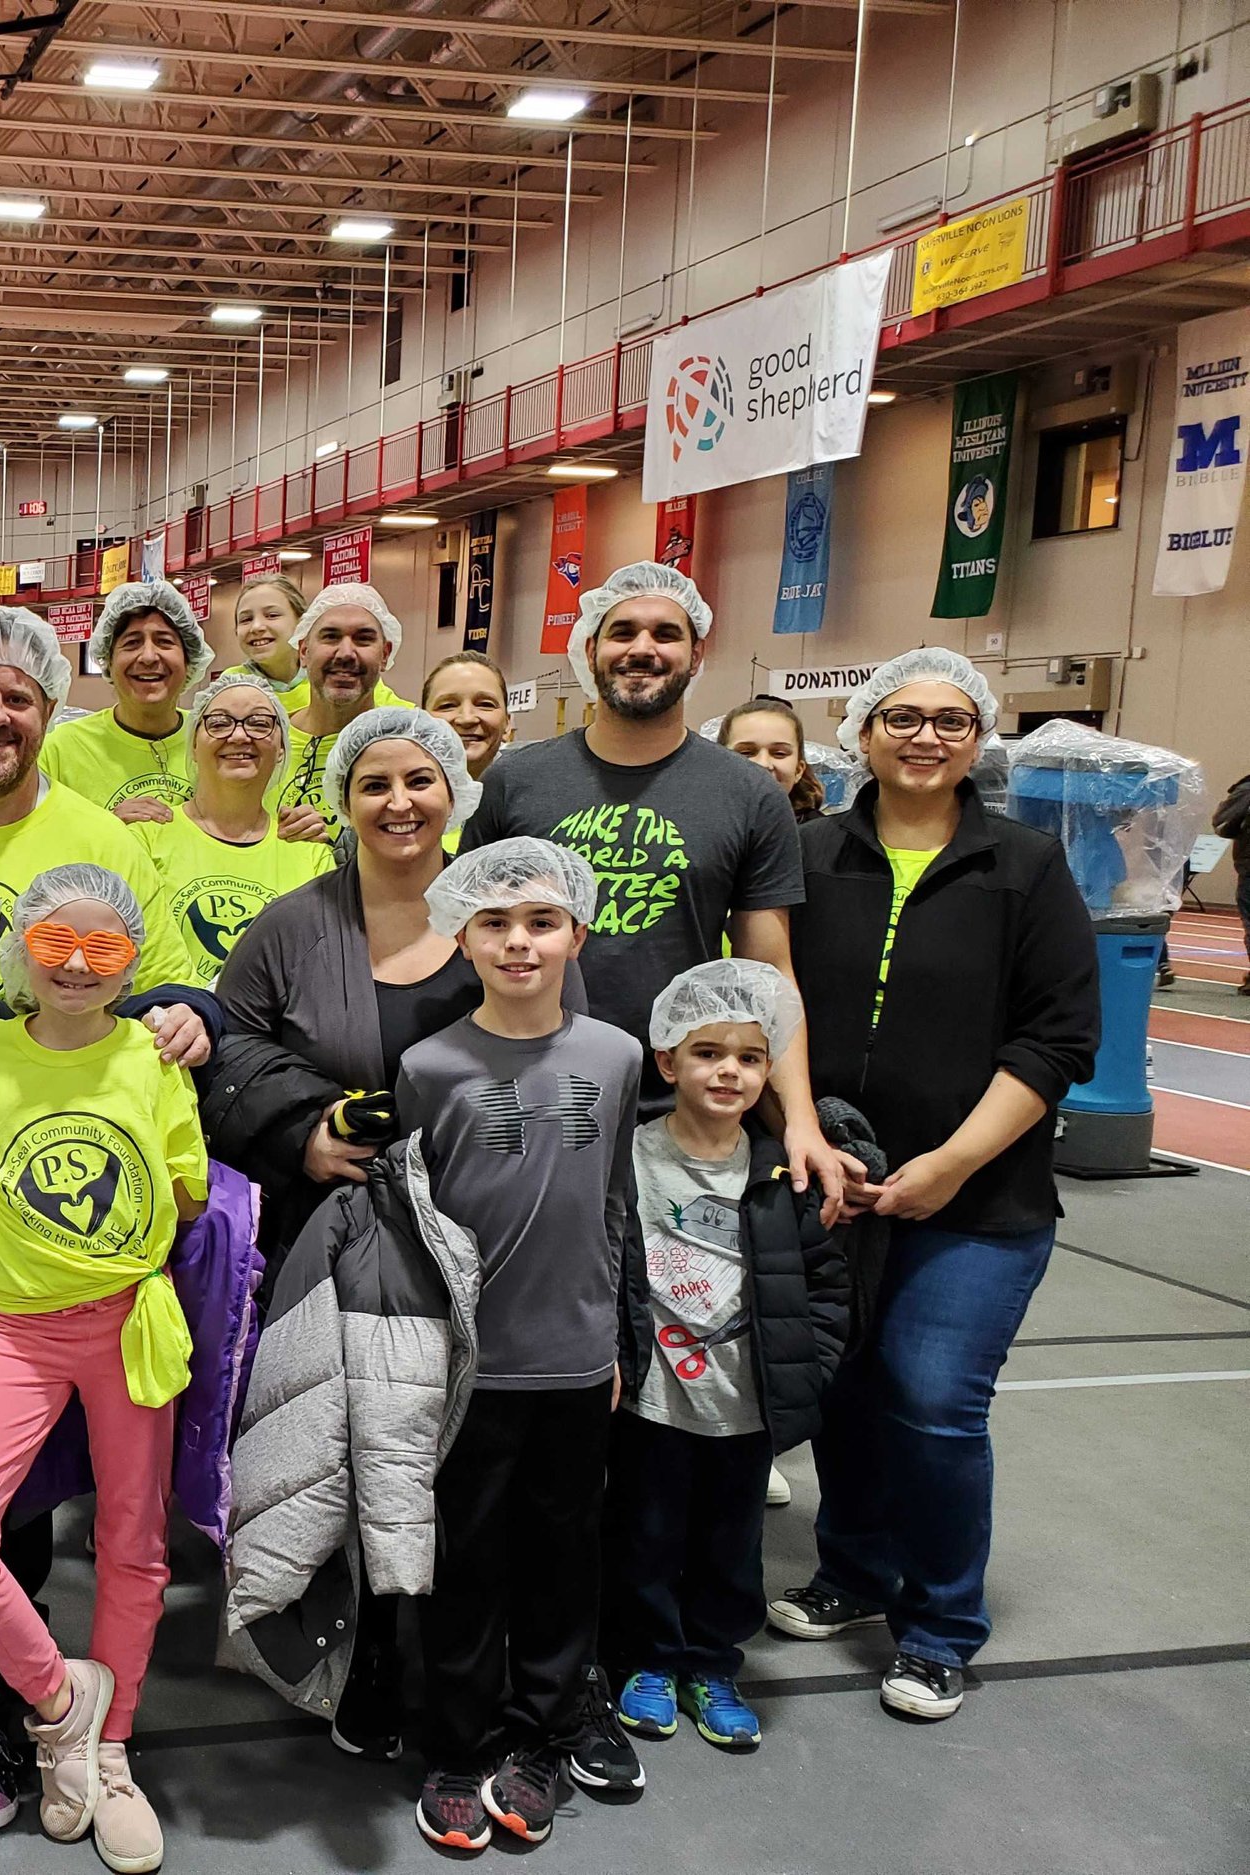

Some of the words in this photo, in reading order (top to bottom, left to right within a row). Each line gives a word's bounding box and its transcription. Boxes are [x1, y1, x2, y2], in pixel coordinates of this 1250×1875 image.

[966, 217, 996, 234] NOON
[998, 205, 1023, 223] LIONS
[940, 255, 956, 266] WE
[749, 333, 812, 390] good
[747, 359, 863, 422] shepherd
[1176, 415, 1242, 472] M
[952, 558, 996, 579] TITANS
[510, 689, 531, 706] FFLE
[550, 803, 630, 844] MAKE
[633, 808, 685, 845] THE
[556, 842, 649, 868] ORLD
[663, 849, 690, 869] A
[202, 879, 266, 895] Community
[593, 872, 681, 899] TTER
[207, 895, 252, 918] P.S.
[588, 900, 675, 935] ACE
[31, 1125, 106, 1145] Community
[107, 1134, 143, 1204] Foundation
[38, 1149, 97, 1187] P.S.
[16, 1199, 52, 1239] Making
[54, 1233, 76, 1248] the
[672, 1279, 713, 1301] PAPER
